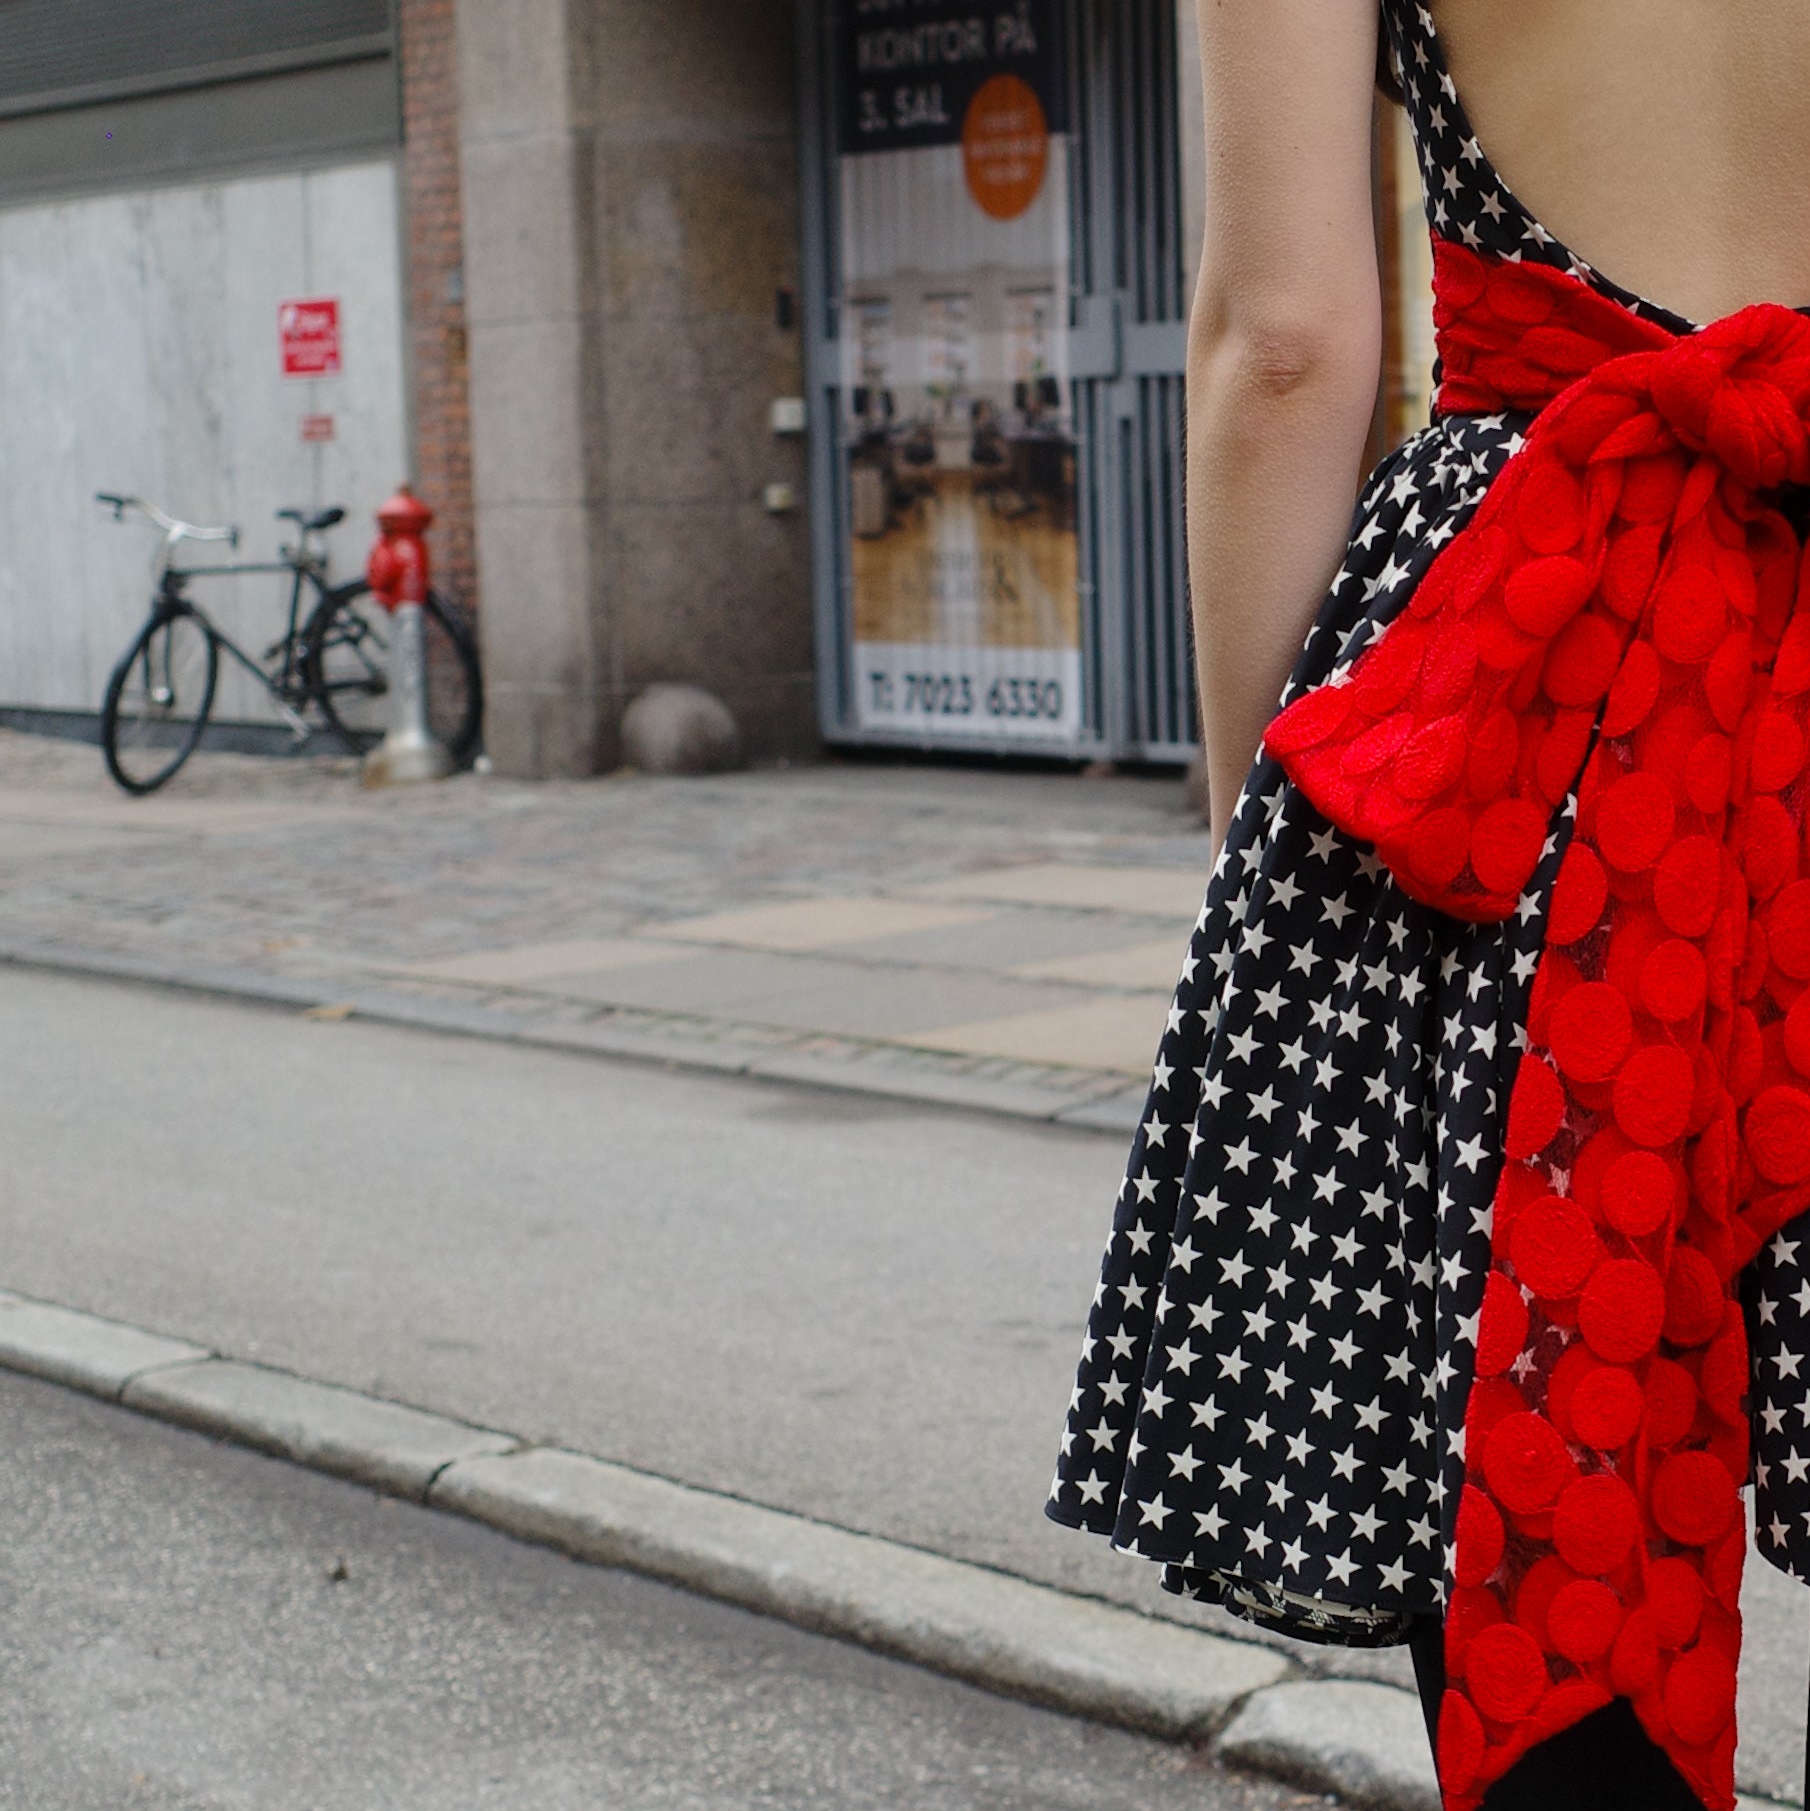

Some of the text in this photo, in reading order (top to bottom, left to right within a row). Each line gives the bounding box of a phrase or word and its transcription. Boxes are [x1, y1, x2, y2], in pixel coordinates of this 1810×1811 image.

[857, 18, 986, 71] KONTOR
[894, 82, 950, 130] SAL
[868, 671, 1064, 721] T: 7023 6330
